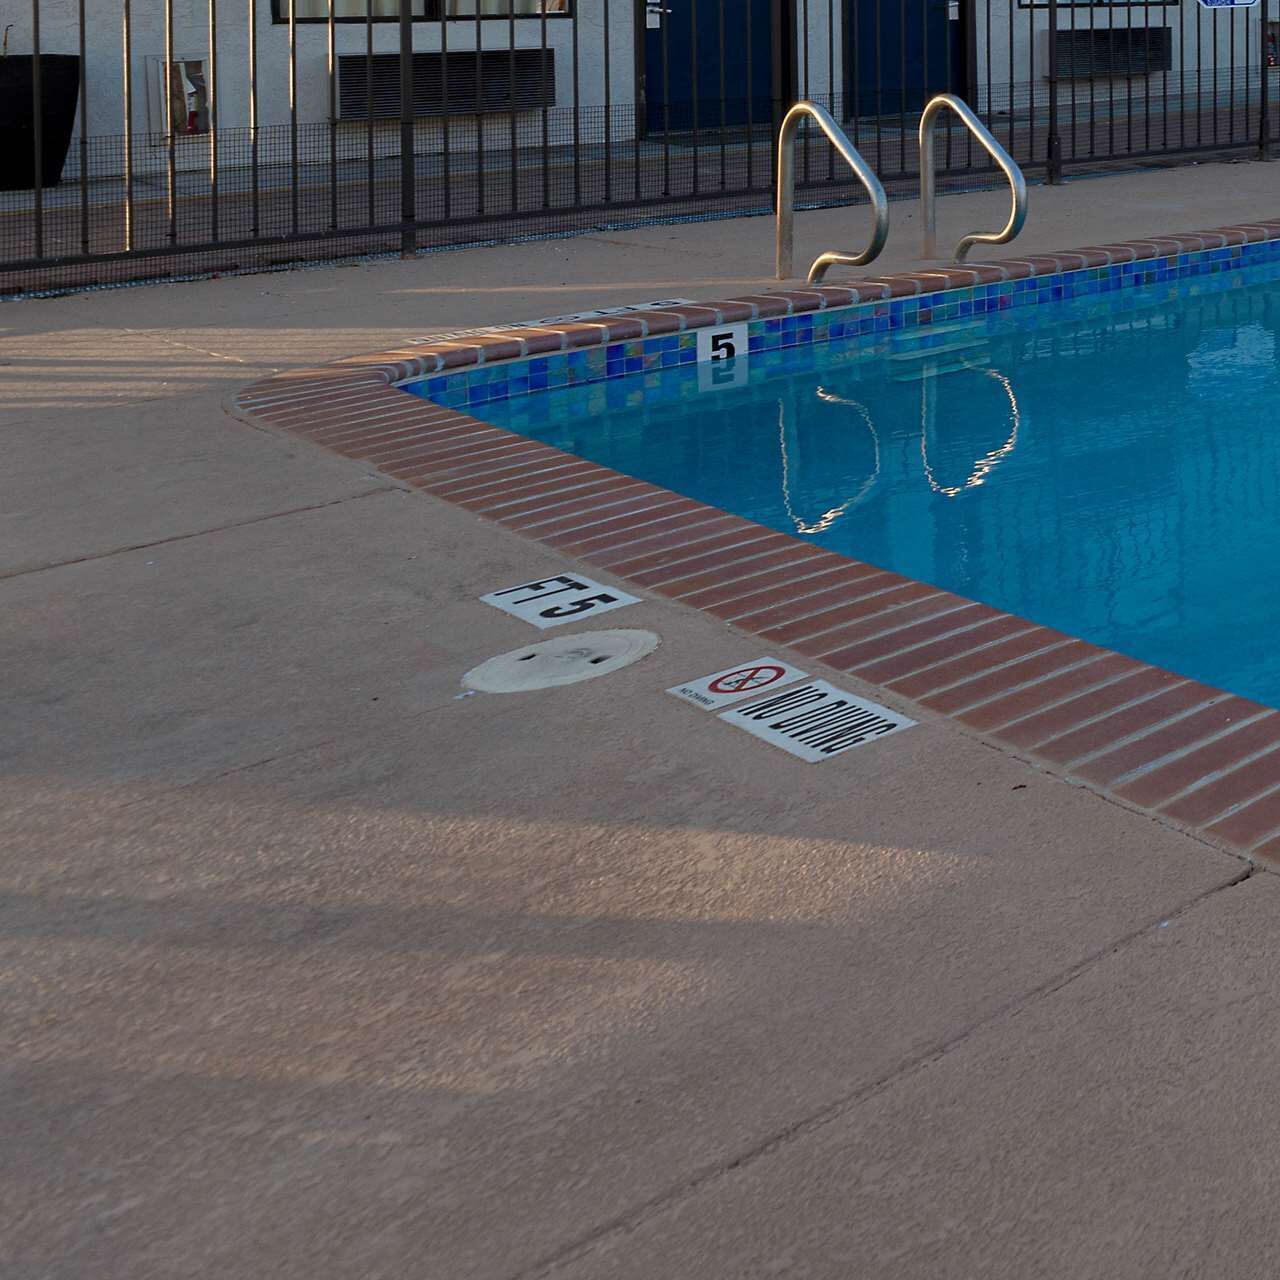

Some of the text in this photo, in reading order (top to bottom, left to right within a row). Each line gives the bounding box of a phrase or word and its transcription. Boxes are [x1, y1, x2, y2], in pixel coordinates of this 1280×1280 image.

[711, 332, 736, 360] 5
[494, 576, 618, 618] FT 5
[737, 686, 898, 753] NO DIVING
